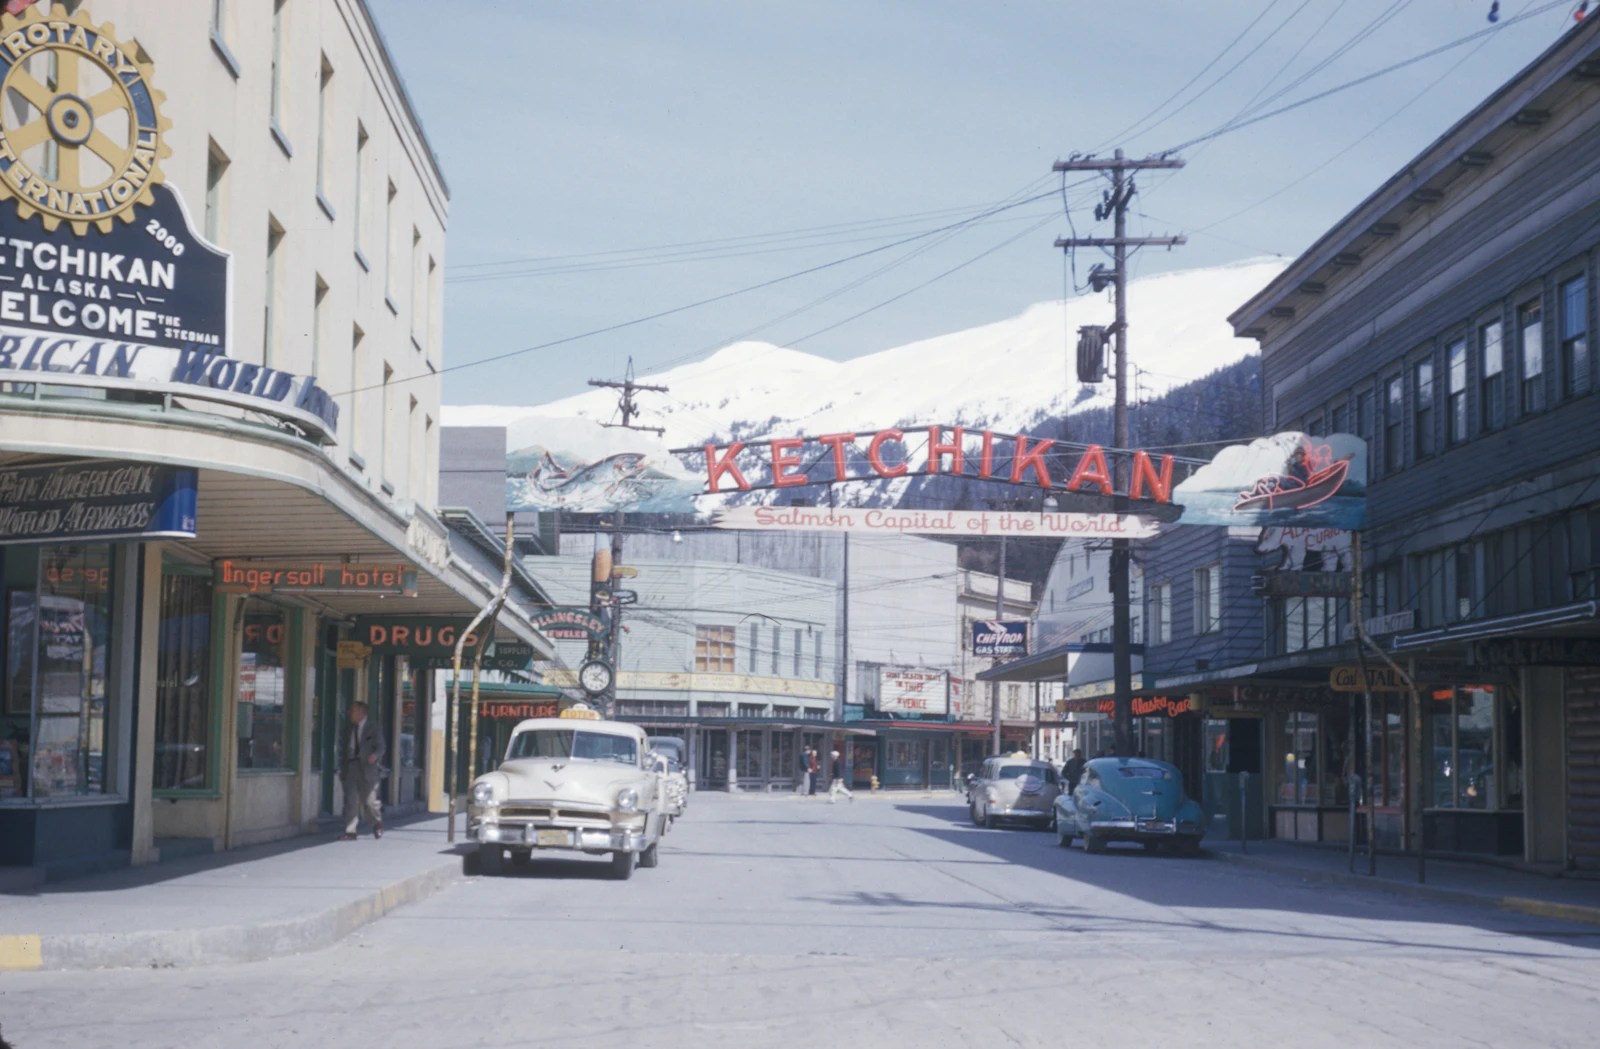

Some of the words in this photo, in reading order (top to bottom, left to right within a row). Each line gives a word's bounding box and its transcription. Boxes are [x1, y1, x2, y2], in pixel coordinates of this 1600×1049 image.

[4, 22, 138, 76] ROTARY
[0, 132, 157, 216] TERNATIONAL
[145, 219, 185, 256] 2000
[0, 236, 175, 290] TCHIKAN
[21, 273, 112, 300] ALASKA
[0, 291, 157, 338] ELCOME
[157, 314, 181, 327] THE
[0, 335, 147, 377] RICAN
[705, 424, 1173, 503] KETCHIKAN
[754, 507, 854, 527] Salmon
[866, 509, 955, 533] Capital
[966, 512, 989, 533] of
[998, 513, 1036, 531] the
[1042, 514, 1126, 533] World
[341, 563, 404, 586] hotel
[370, 625, 479, 647] DRUGS
[547, 630, 588, 639] EWELER
[976, 631, 1024, 646] CHEVRON
[975, 646, 993, 655] GAS
[1131, 696, 1168, 716] Alaska
